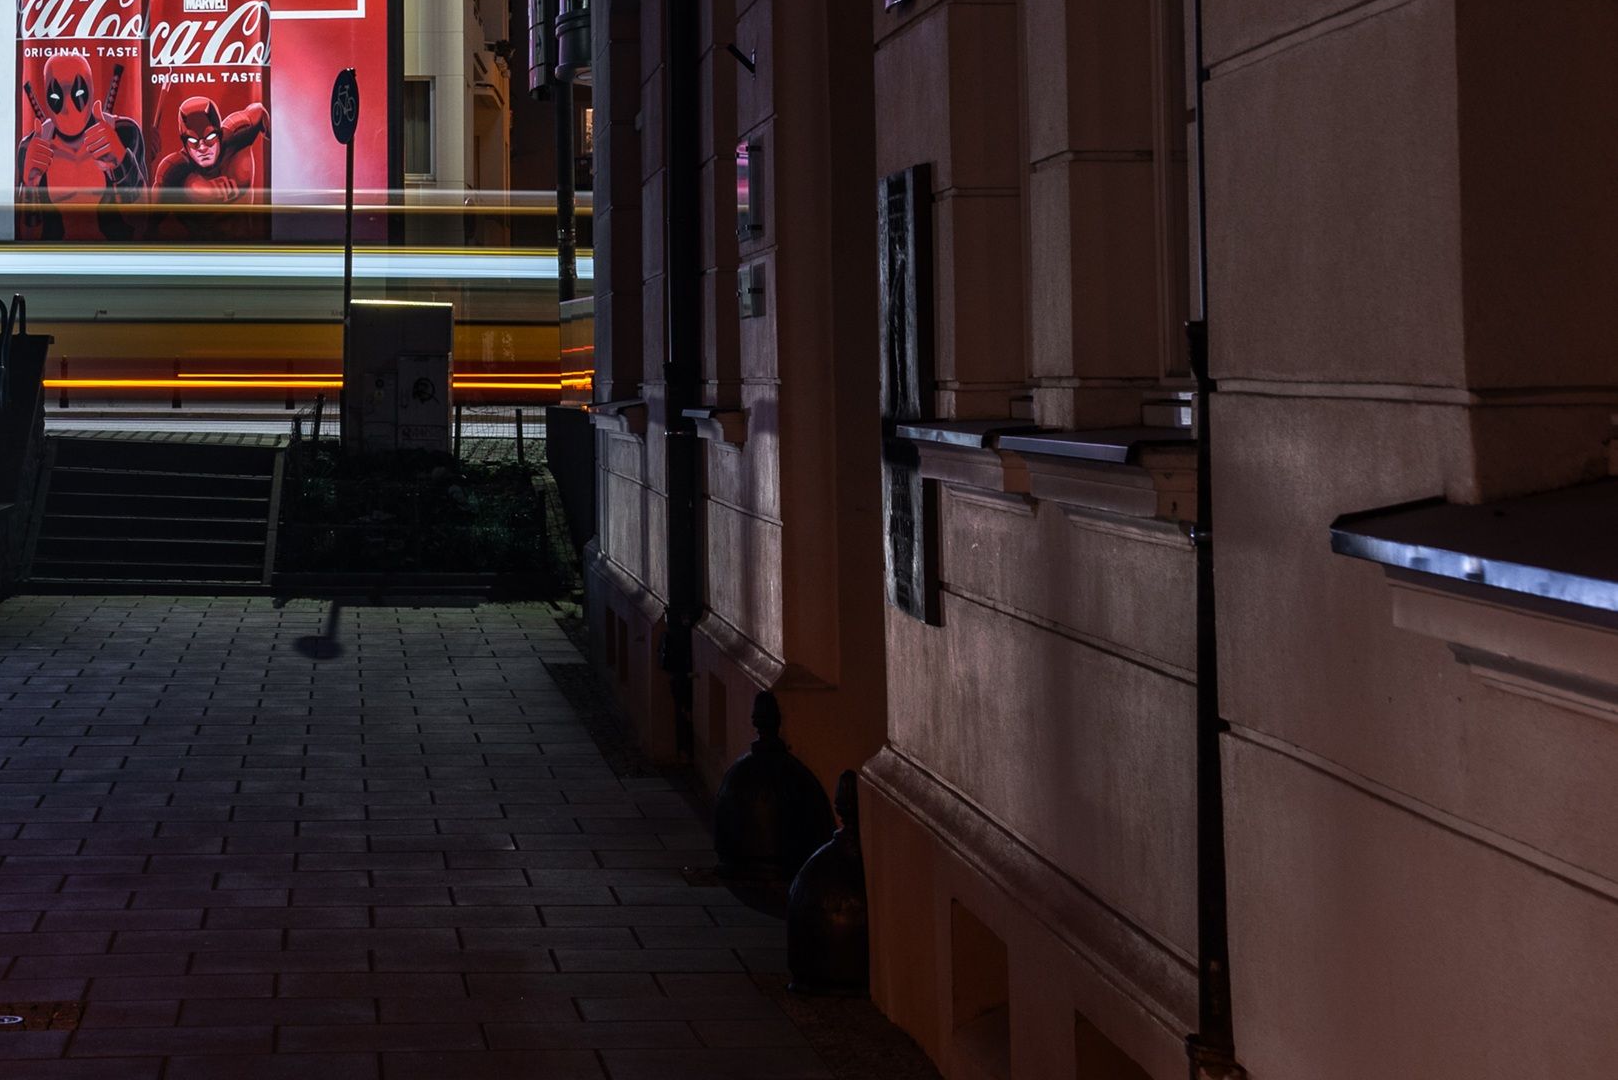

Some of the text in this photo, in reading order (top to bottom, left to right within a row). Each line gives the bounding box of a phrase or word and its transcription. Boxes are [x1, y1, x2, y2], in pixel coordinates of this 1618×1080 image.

[24, 46, 138, 58] ORIGINAL TASTE
[151, 72, 261, 84] ORIGINAL TASTE
